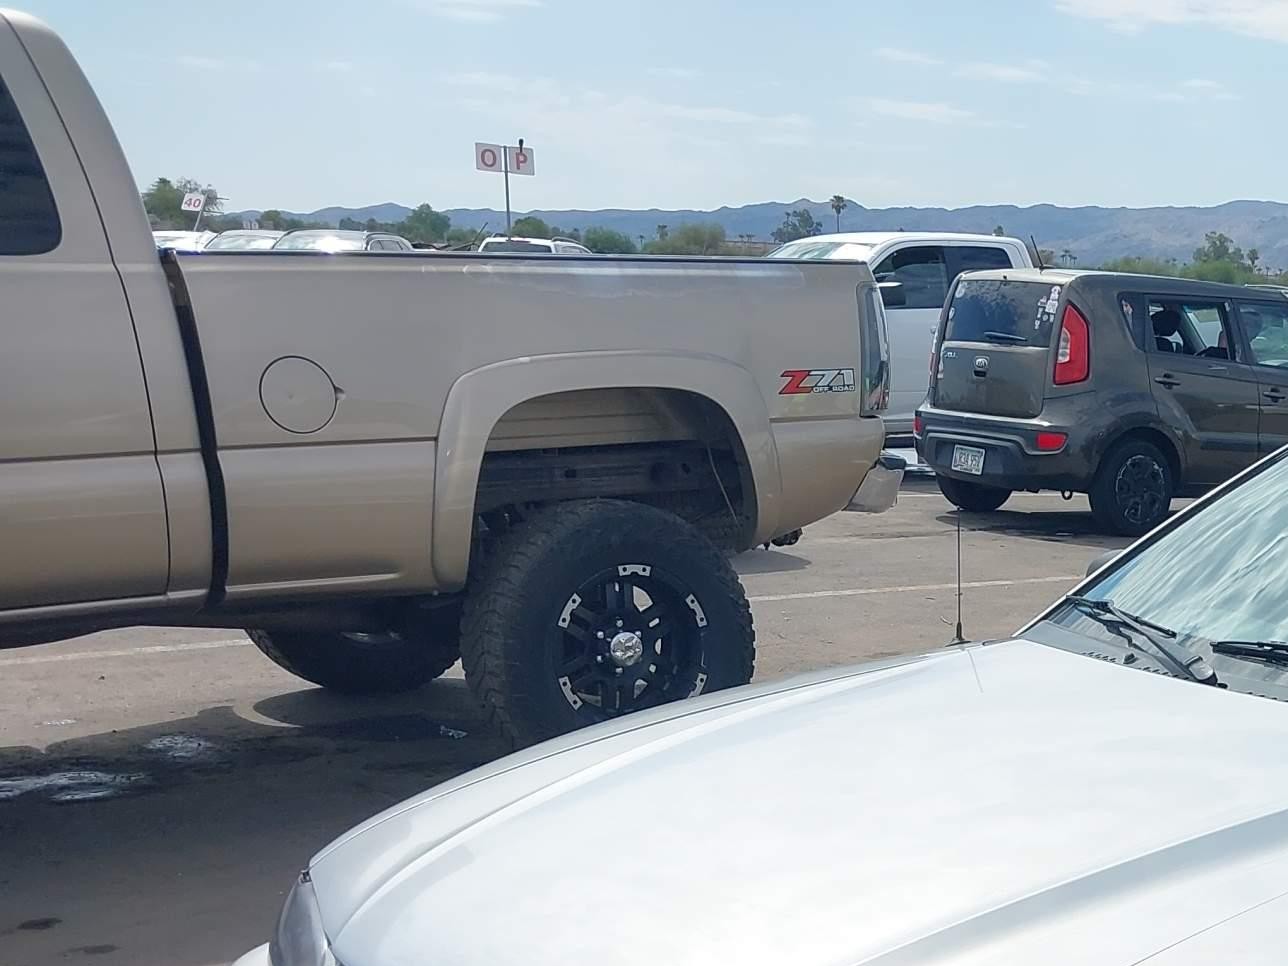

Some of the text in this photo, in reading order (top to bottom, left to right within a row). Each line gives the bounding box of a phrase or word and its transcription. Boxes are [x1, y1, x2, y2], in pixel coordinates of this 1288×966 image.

[481, 149, 528, 170] O P
[185, 198, 201, 208] 40
[779, 368, 855, 394] Z71
